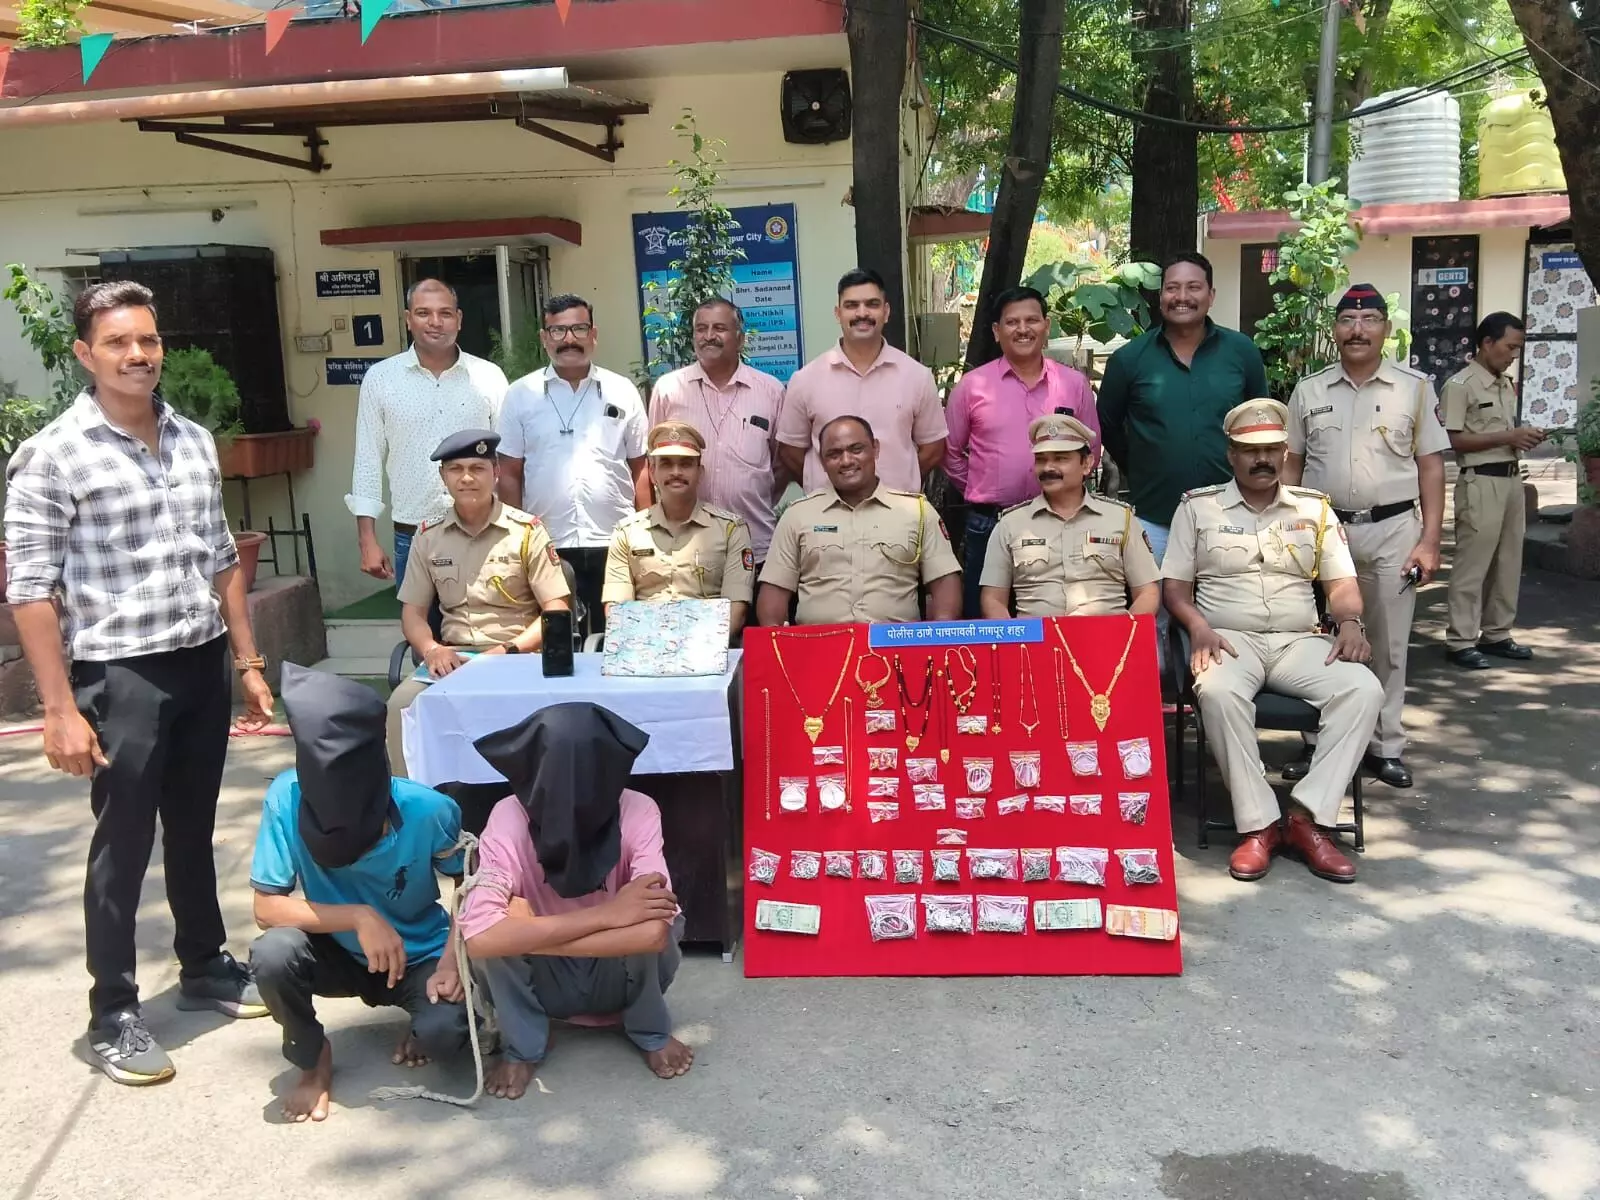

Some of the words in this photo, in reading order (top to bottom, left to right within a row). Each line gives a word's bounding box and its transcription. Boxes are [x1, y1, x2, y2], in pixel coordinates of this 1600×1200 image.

[746, 232, 762, 242] City
[319, 271, 329, 283] श्री
[331, 271, 361, 283] अनिरुद्ध
[1438, 271, 1464, 281] GENTS
[755, 284, 792, 293] Sadanand
[363, 321, 373, 340] 1
[886, 626, 914, 639] पोलीस
[916, 625, 933, 638] ठाणे
[935, 624, 976, 637] पाचपावली
[979, 625, 1004, 639] नागपूर
[1007, 624, 1026, 637] शहर
